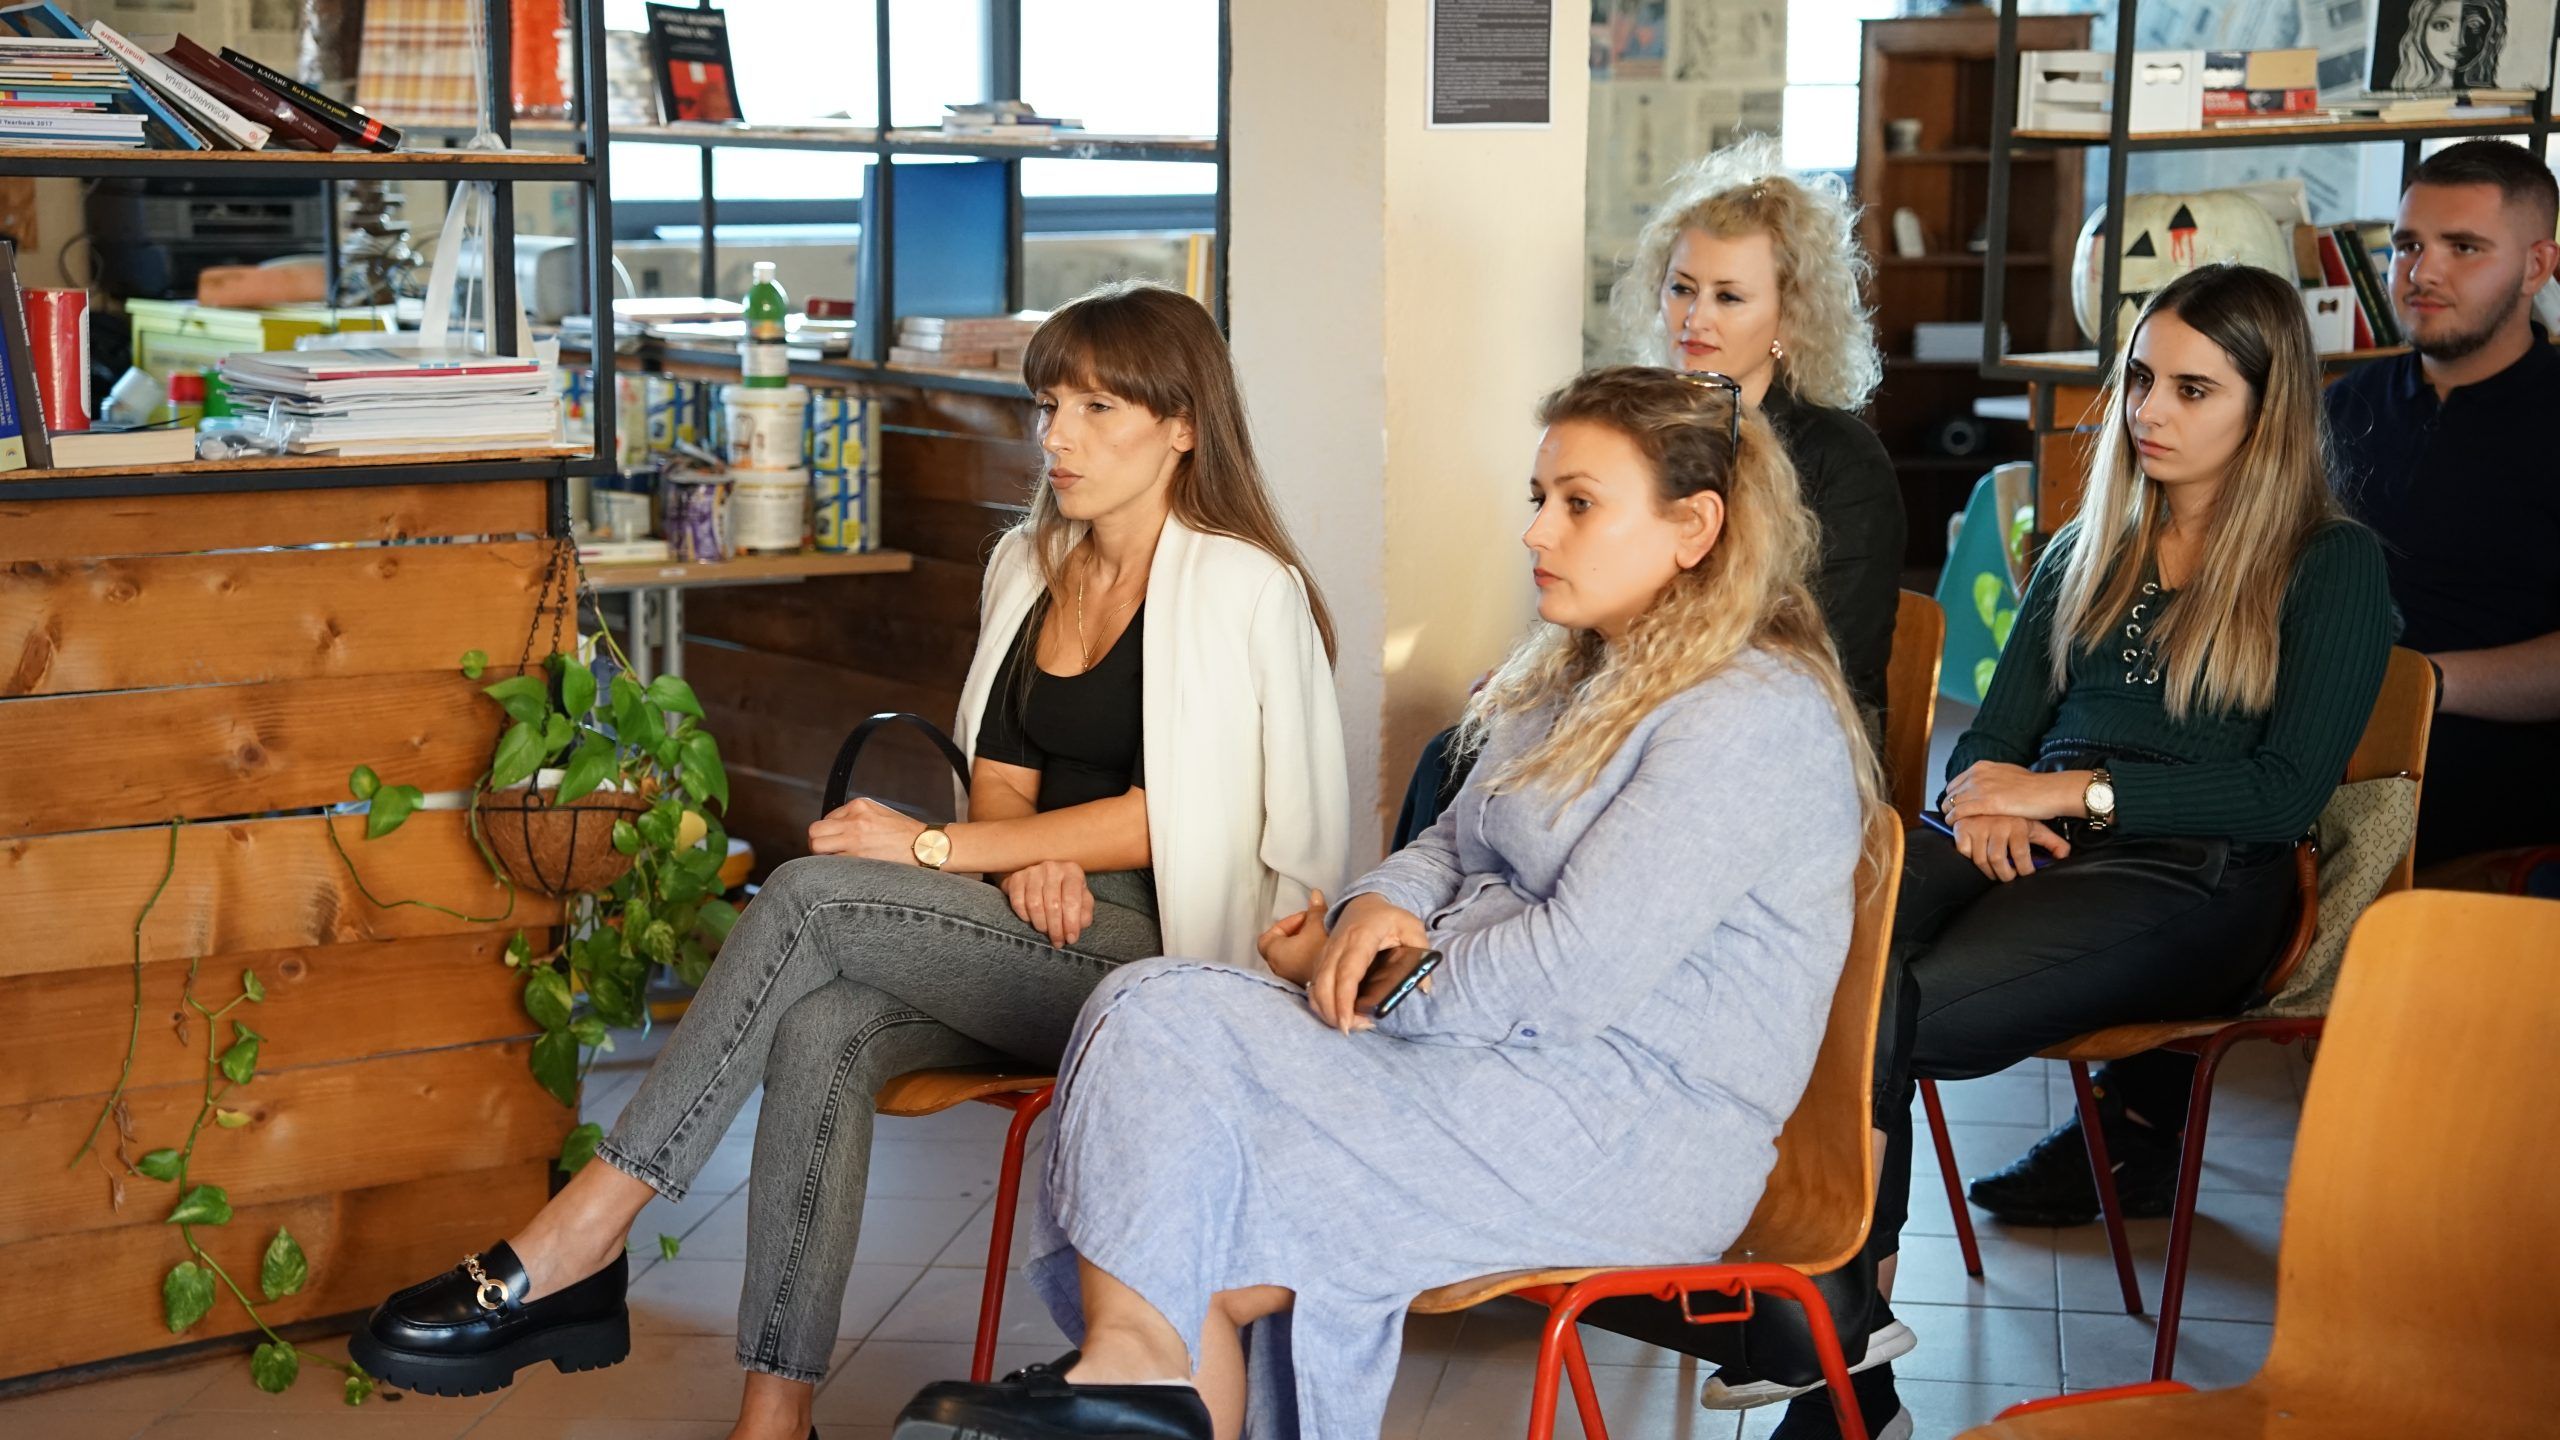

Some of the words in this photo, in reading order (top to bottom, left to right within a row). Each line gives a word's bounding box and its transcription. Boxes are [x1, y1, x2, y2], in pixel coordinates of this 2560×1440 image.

[100, 31, 124, 50] Kadare
[123, 47, 145, 64] Ismail
[257, 68, 288, 87] KADARE
